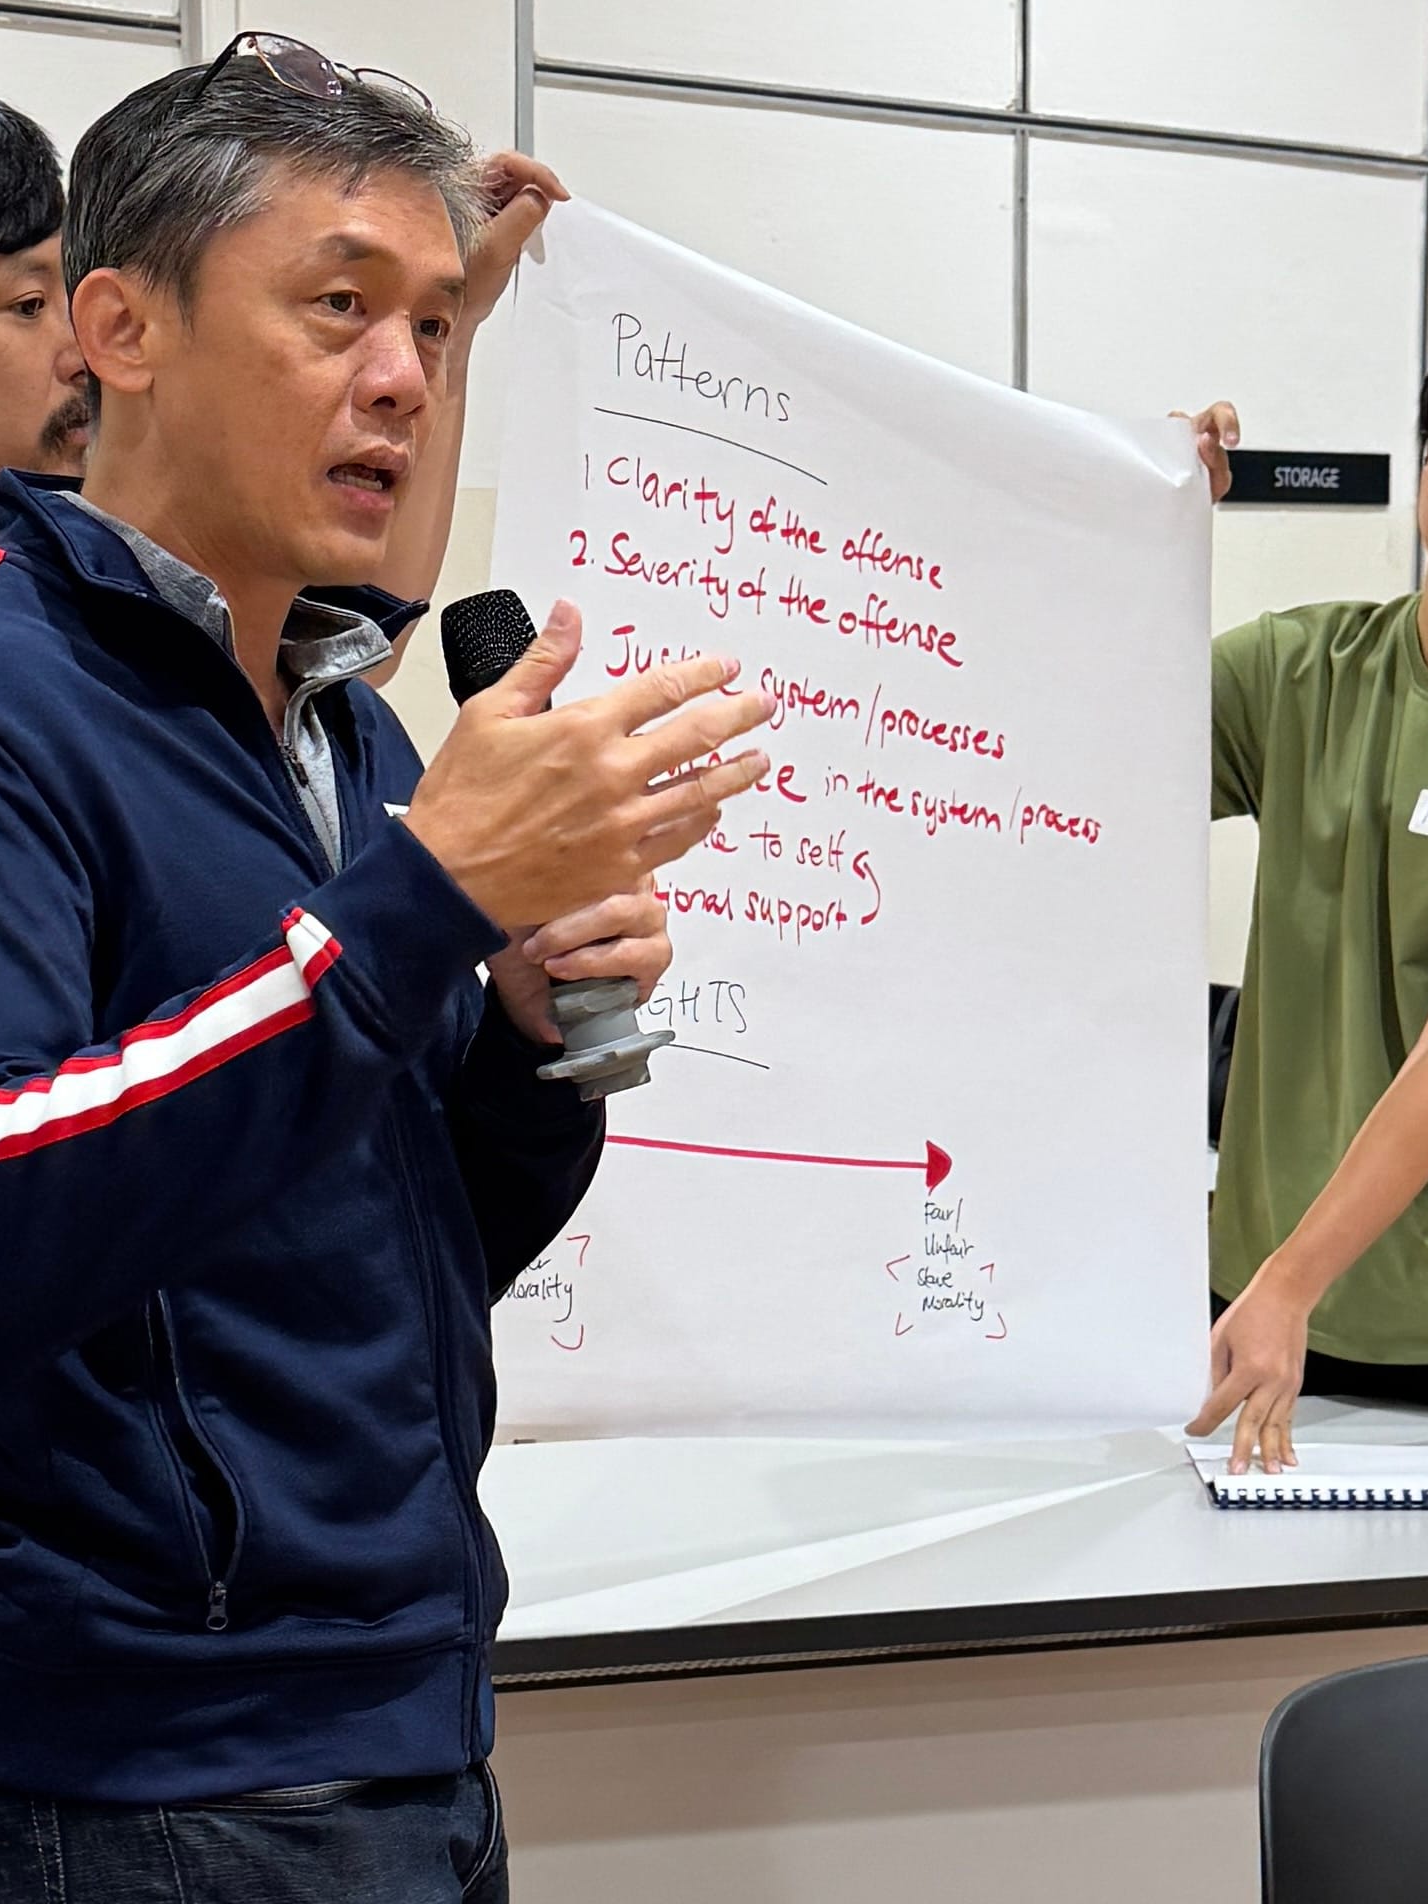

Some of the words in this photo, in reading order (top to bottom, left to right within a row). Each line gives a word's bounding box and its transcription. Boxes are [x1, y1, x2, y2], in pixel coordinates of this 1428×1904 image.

[612, 312, 792, 422] Patterns
[1274, 466, 1341, 489] STORAGE
[606, 456, 736, 554] Clarity
[749, 494, 777, 543] of
[779, 509, 828, 555] the
[841, 527, 944, 590] offense
[569, 529, 595, 567] 2.
[604, 531, 730, 619] Severity
[737, 566, 767, 616] of
[778, 575, 831, 624] the
[838, 592, 964, 668] offense
[824, 765, 849, 797] in
[856, 770, 904, 813] the
[749, 820, 782, 861] to
[796, 829, 847, 873] self
[744, 890, 848, 946] support
